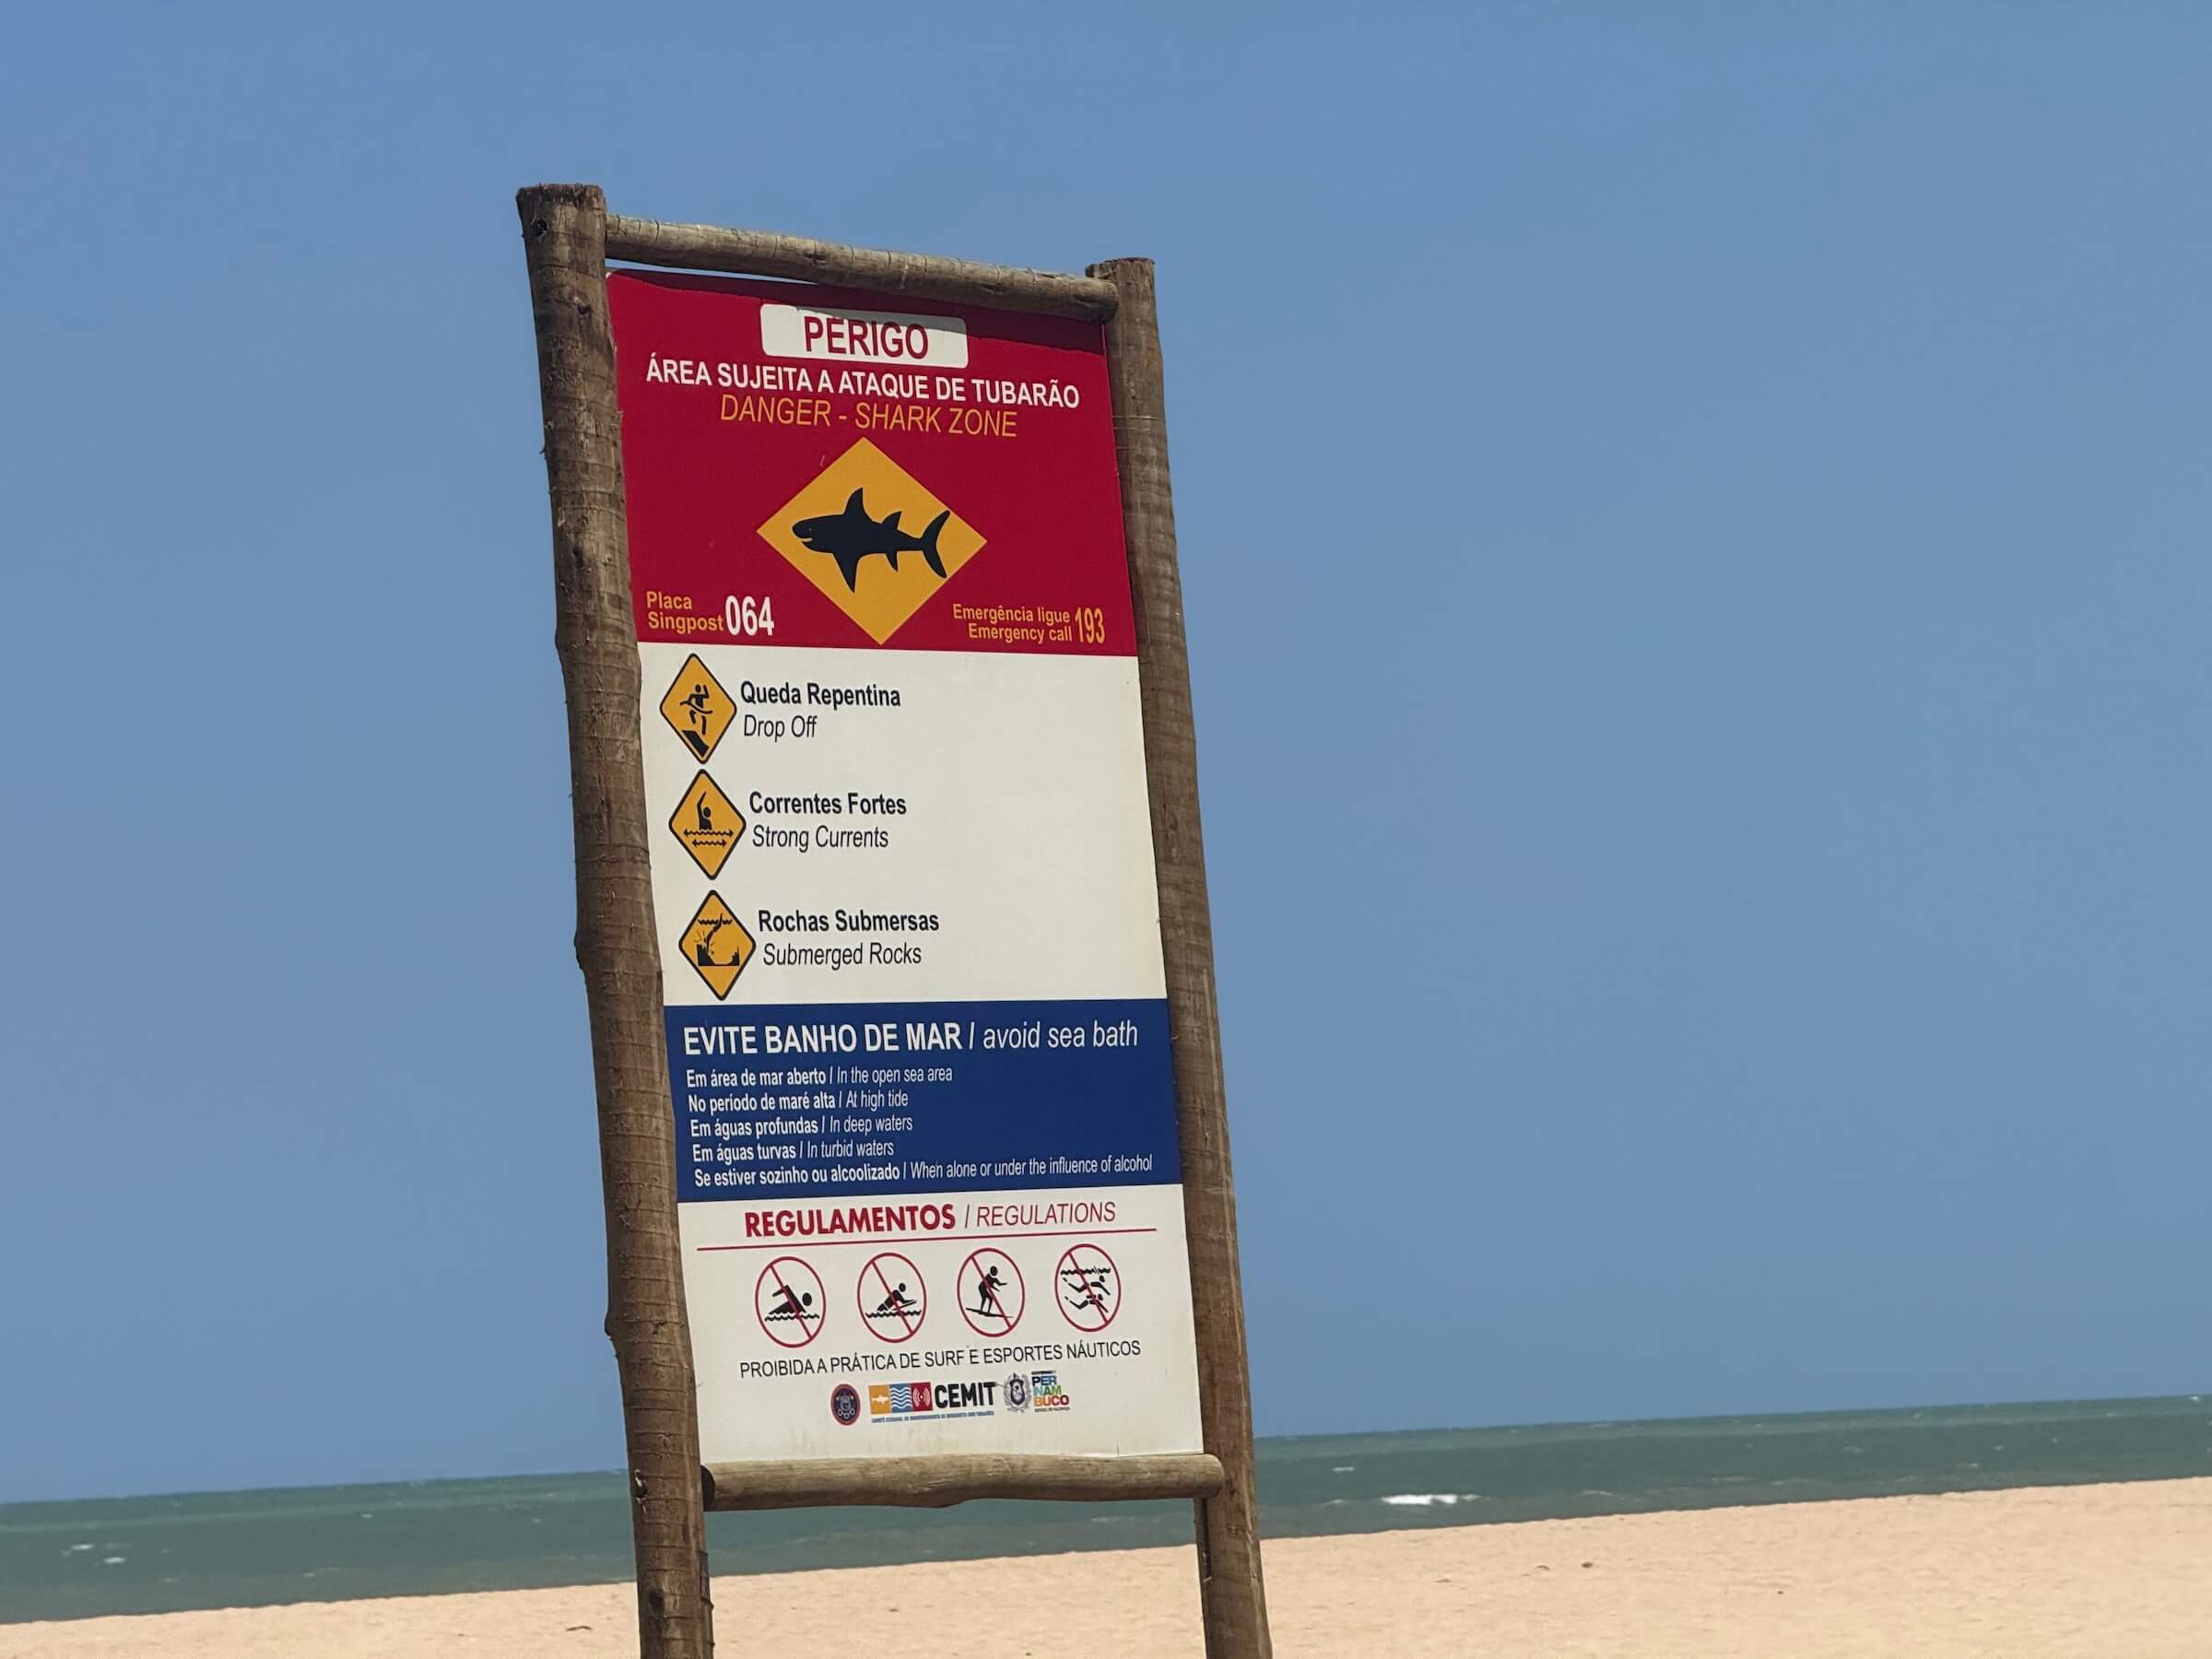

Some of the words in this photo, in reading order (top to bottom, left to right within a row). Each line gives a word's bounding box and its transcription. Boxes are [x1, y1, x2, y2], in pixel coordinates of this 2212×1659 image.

[805, 316, 928, 359] PERIGO
[646, 352, 712, 387] ÁREA
[718, 363, 811, 392] SUJEITA
[817, 368, 834, 393] A
[838, 370, 928, 400] ATAQUE
[935, 375, 967, 401] DE
[975, 378, 1079, 408] TUBARÃO
[720, 394, 831, 427] DANGER
[855, 402, 942, 432] SHARK
[947, 407, 1018, 437] ZONE
[646, 590, 692, 611] Placa
[648, 611, 724, 634] Singpost
[724, 594, 774, 636] 064
[952, 603, 1033, 625] Emergência
[1037, 606, 1070, 627] ligue
[1075, 606, 1105, 644] 193
[968, 621, 1042, 644] Emergency
[1045, 624, 1073, 642] call
[740, 681, 801, 704] Queda
[807, 683, 900, 710] Repentina
[744, 714, 784, 742] Drop
[791, 715, 818, 737] Off
[749, 791, 841, 815] Correntes
[848, 793, 907, 815] Fortes
[752, 825, 809, 853] Strong
[816, 826, 888, 848] Currents
[758, 910, 830, 933] Rochas
[835, 910, 939, 931] Submersas
[763, 943, 863, 970] Submerged
[870, 943, 922, 964] Rocks
[683, 1026, 758, 1055] EVITE
[765, 1024, 857, 1053] BANHO
[865, 1024, 900, 1052] DE
[906, 1022, 962, 1051] MAR
[970, 1022, 975, 1050] /
[982, 1021, 1041, 1050] avoid
[1047, 1026, 1086, 1048] sea
[1092, 1020, 1138, 1047] bath
[686, 1069, 707, 1088] Em
[710, 1067, 738, 1087] área
[741, 1067, 757, 1086] de
[759, 1071, 783, 1086] mar
[787, 1066, 826, 1085] aberto
[829, 1066, 833, 1084] /
[837, 1066, 848, 1083] In
[851, 1066, 870, 1083] the
[873, 1068, 900, 1086] open
[904, 1068, 924, 1082] sea
[927, 1067, 953, 1082] area
[688, 1095, 706, 1112] No
[710, 1092, 758, 1115] período
[760, 1092, 776, 1111] de
[779, 1090, 810, 1111] maré
[813, 1091, 835, 1109] alta
[839, 1090, 842, 1108] /
[846, 1091, 857, 1108] At
[860, 1089, 885, 1111] high
[888, 1089, 908, 1107] tide
[690, 1120, 712, 1137] Em
[714, 1118, 752, 1141] águas
[755, 1116, 818, 1139] profundas
[821, 1115, 826, 1134] /
[830, 1115, 841, 1133] In
[843, 1115, 872, 1135] deep
[875, 1115, 912, 1132] waters
[692, 1145, 713, 1163] Em
[717, 1142, 754, 1165] águas
[758, 1142, 796, 1160] turvas
[799, 1141, 803, 1159] /
[807, 1141, 818, 1158] In
[821, 1139, 853, 1158] turbid
[856, 1141, 894, 1157] waters
[695, 1170, 712, 1187] Se
[714, 1168, 757, 1187] estiver
[759, 1166, 808, 1185] sozinho
[812, 1170, 828, 1183] ou
[830, 1163, 900, 1182] alcoolizado
[903, 1162, 907, 1180] /
[911, 1160, 943, 1180] When
[947, 1160, 976, 1179] alone
[980, 1164, 992, 1177] or
[994, 1159, 1025, 1176] under
[1029, 1158, 1046, 1175] the
[1050, 1156, 1098, 1174] influence
[1101, 1155, 1112, 1172] of
[1114, 1154, 1152, 1172] alcohol
[745, 1204, 956, 1238] REGULAMENTOS
[964, 1204, 971, 1229] /
[976, 1202, 1116, 1228] REGULATIONS
[740, 1359, 815, 1378] PROIBIDA
[816, 1357, 828, 1374] A
[830, 1352, 898, 1373] PRÁTICA
[900, 1351, 921, 1370] DE
[924, 1348, 963, 1369] SURF
[970, 1347, 980, 1365] E
[982, 1345, 1063, 1364] ESPORTES
[1066, 1339, 1141, 1359] NÁUTICOS
[1032, 1375, 1057, 1384] PER
[1033, 1385, 1061, 1396] NAM
[935, 1382, 995, 1409] CEMIT
[1033, 1395, 1070, 1406] BUCO
